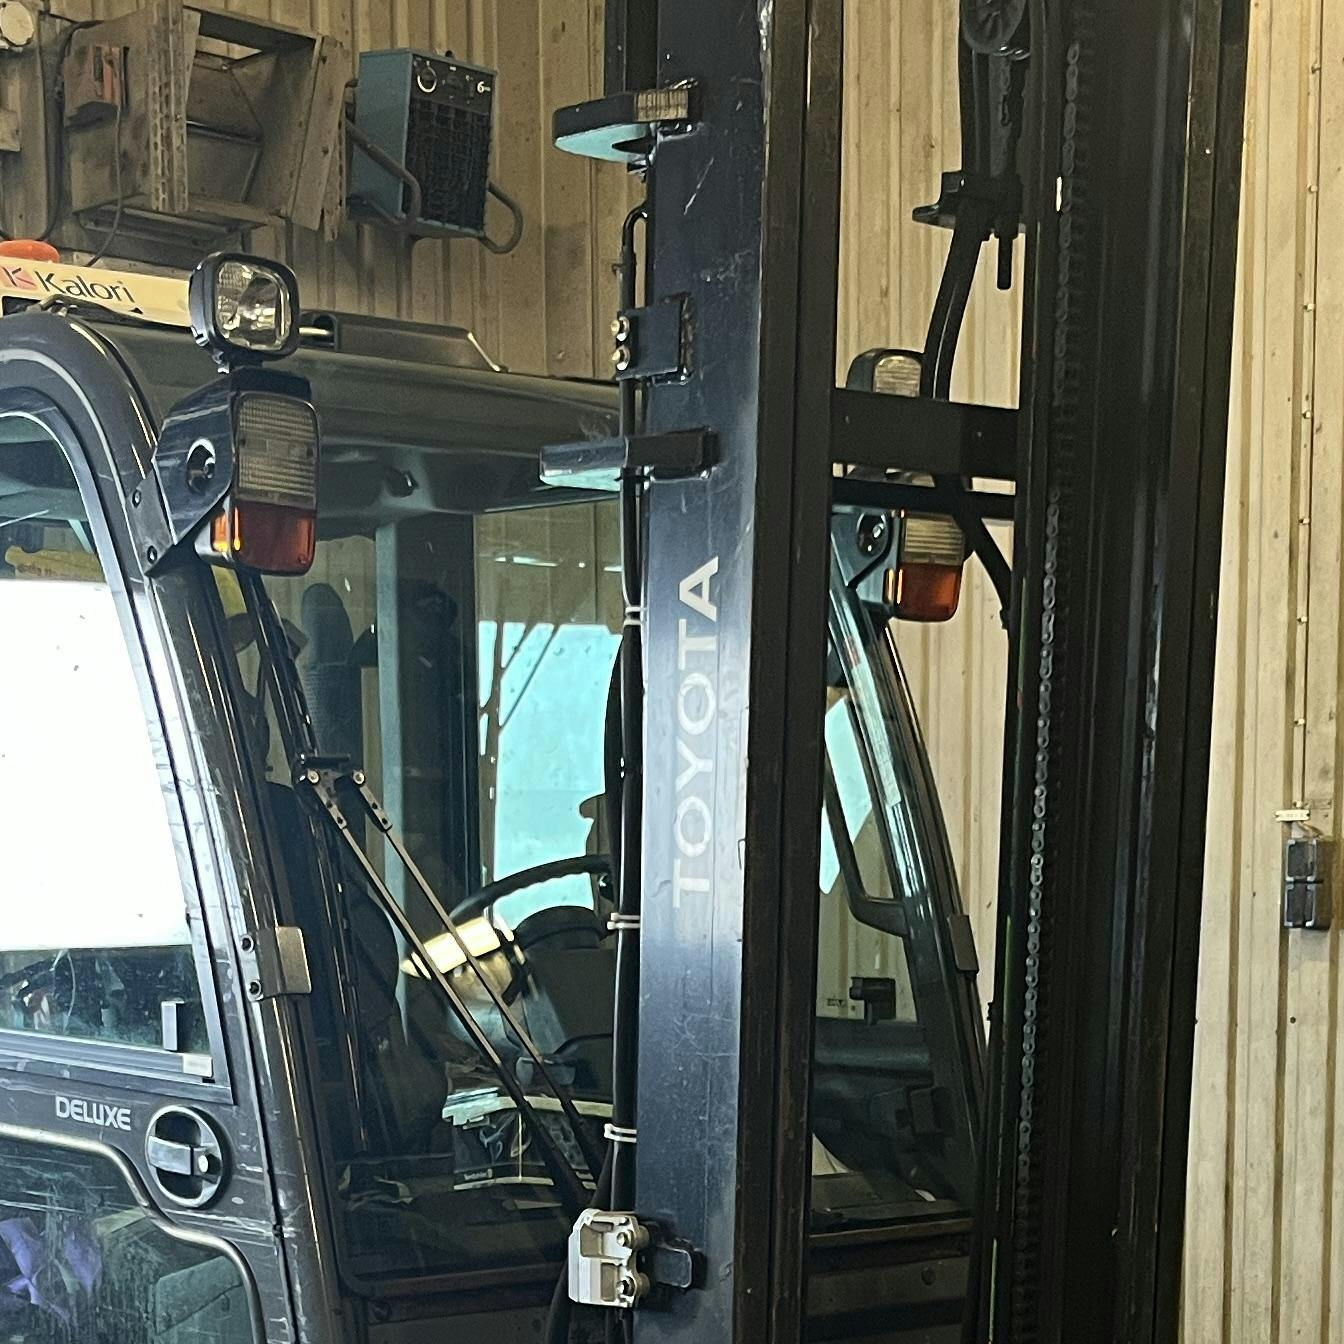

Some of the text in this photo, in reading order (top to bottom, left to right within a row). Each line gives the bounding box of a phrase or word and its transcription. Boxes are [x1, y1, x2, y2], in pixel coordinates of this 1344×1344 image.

[35, 270, 136, 303] Kalori
[672, 556, 719, 908] TOYOTA
[55, 1095, 131, 1131] DELUXE
